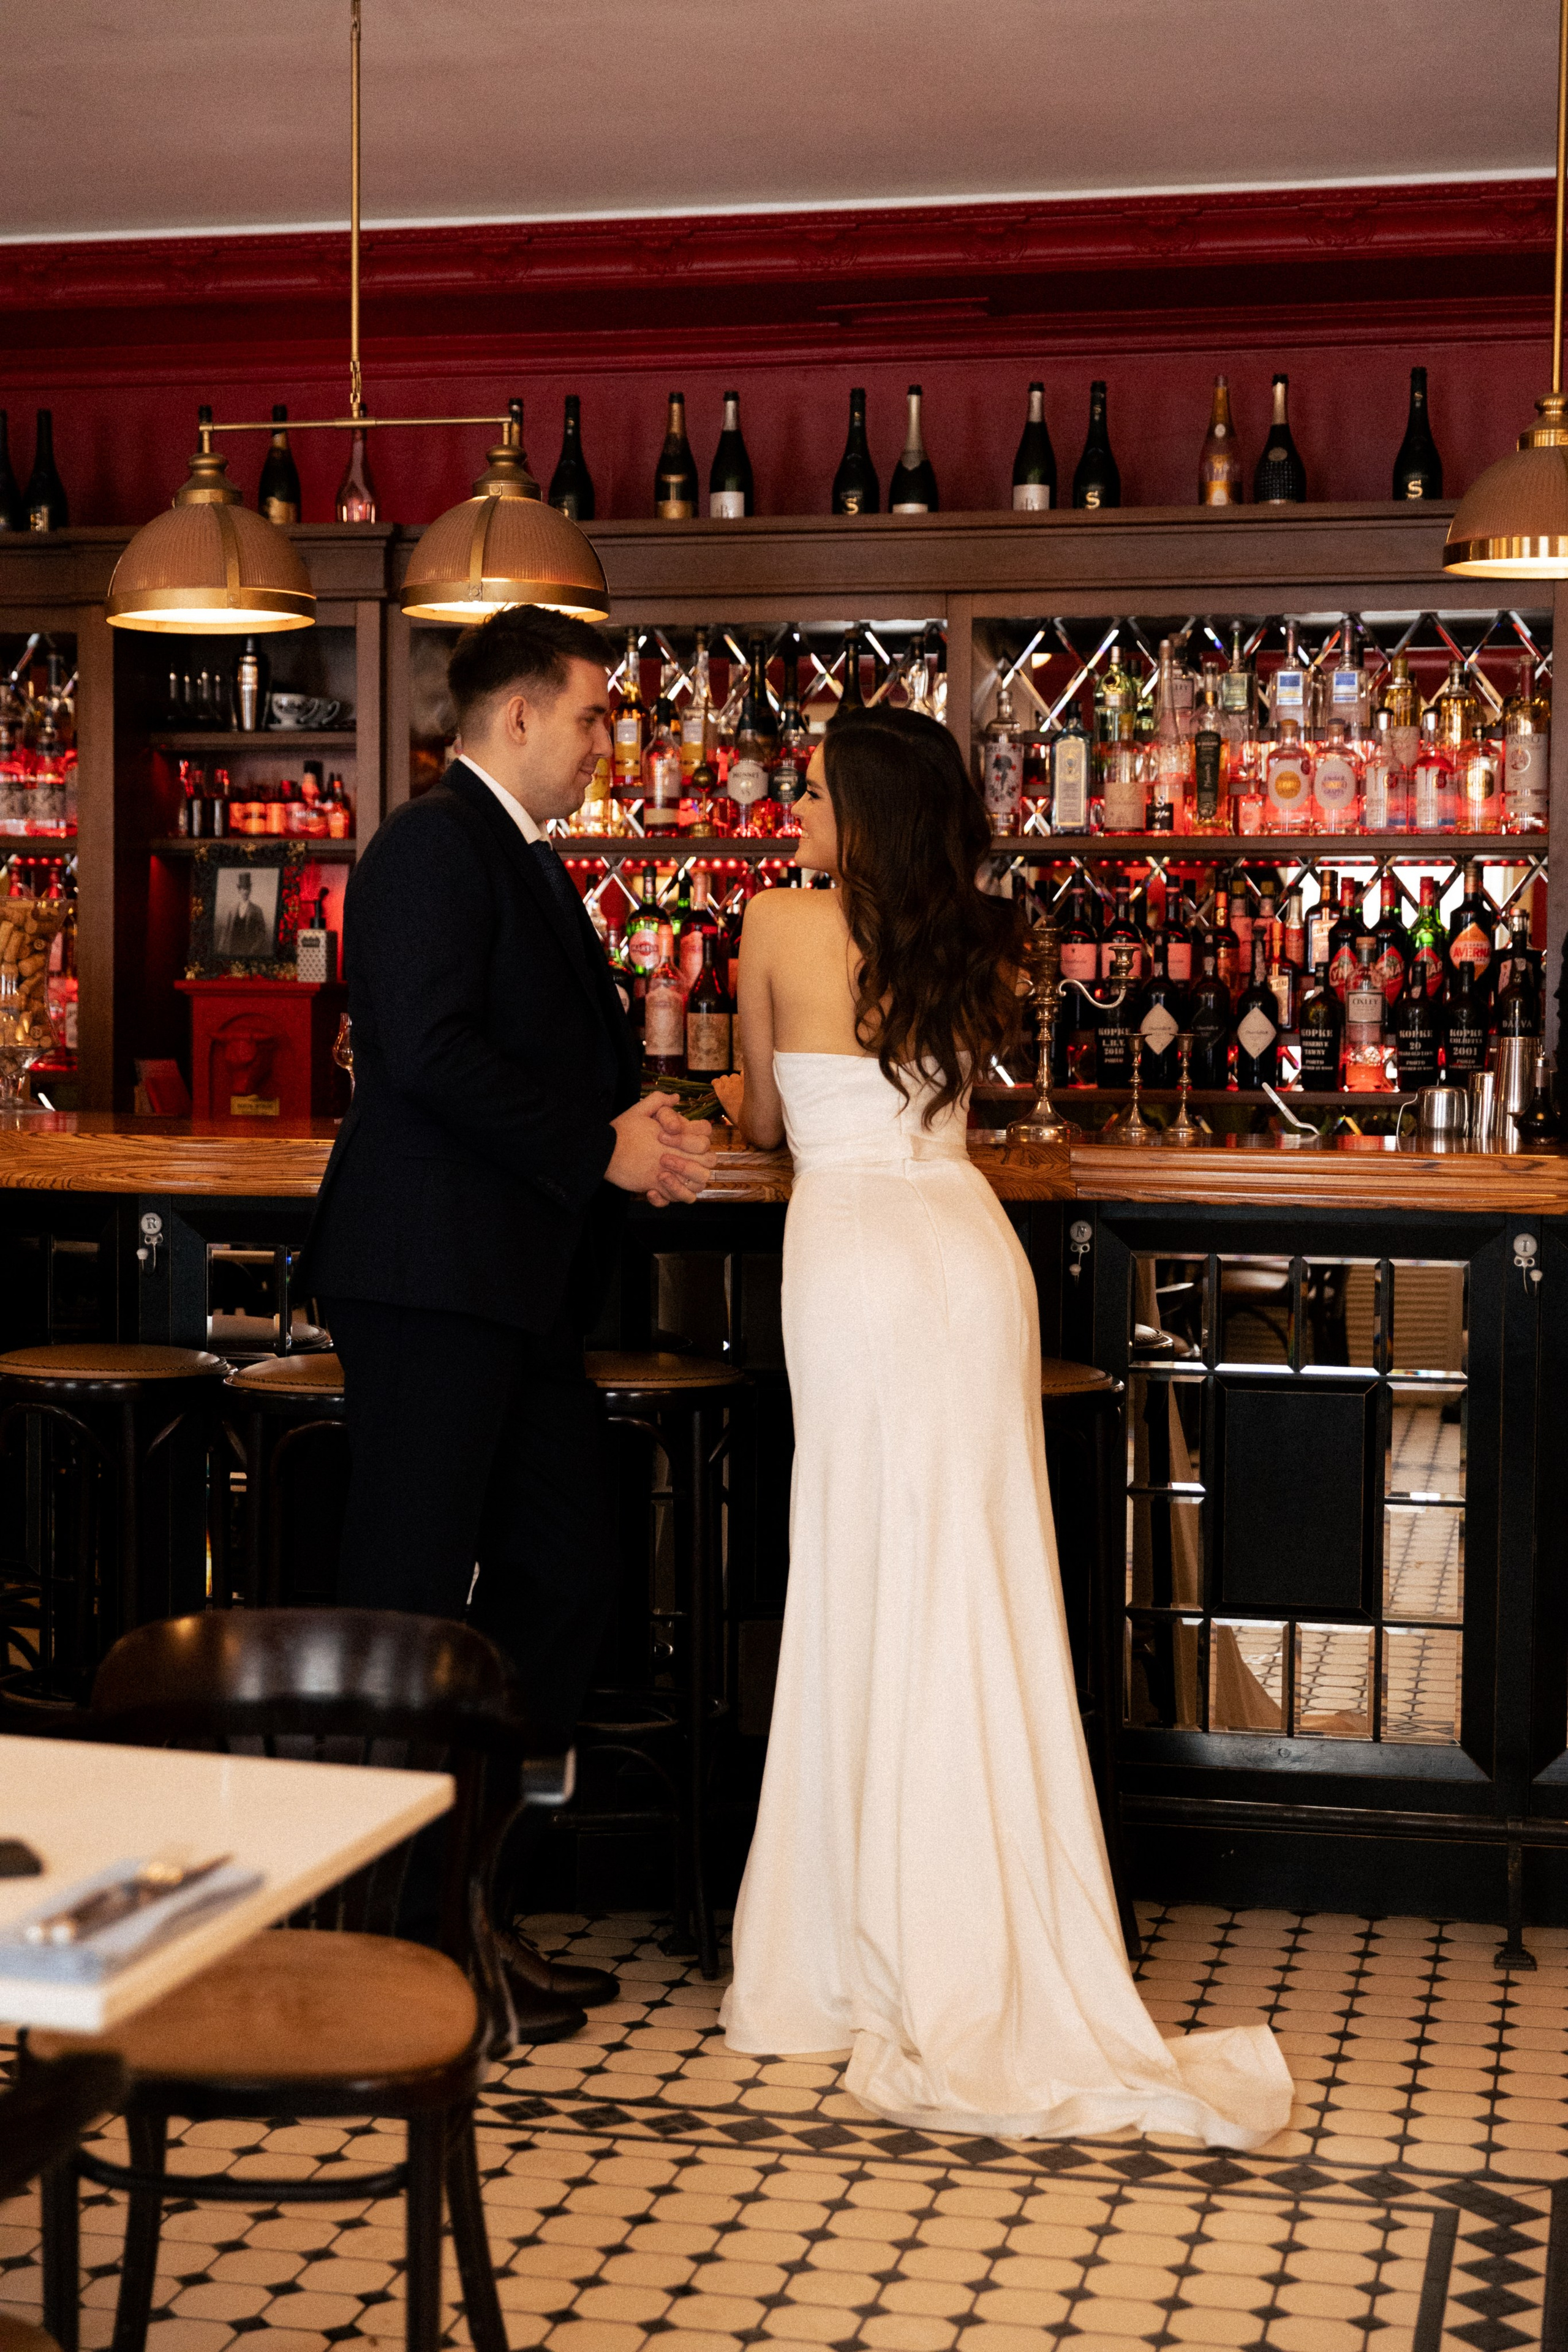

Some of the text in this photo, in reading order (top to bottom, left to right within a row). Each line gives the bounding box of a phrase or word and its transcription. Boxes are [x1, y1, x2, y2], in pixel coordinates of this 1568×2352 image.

[1406, 480, 1423, 499] S
[1085, 491, 1101, 510] S
[844, 497, 859, 515] S
[1453, 948, 1490, 957] AVERNA
[1400, 1030, 1433, 1038] KOPKE
[1449, 1028, 1483, 1038] KOPKE
[1409, 1042, 1422, 1050] 20
[1453, 1047, 1477, 1056] 2001
[146, 1218, 157, 1229] R
[1077, 1226, 1086, 1237] N
